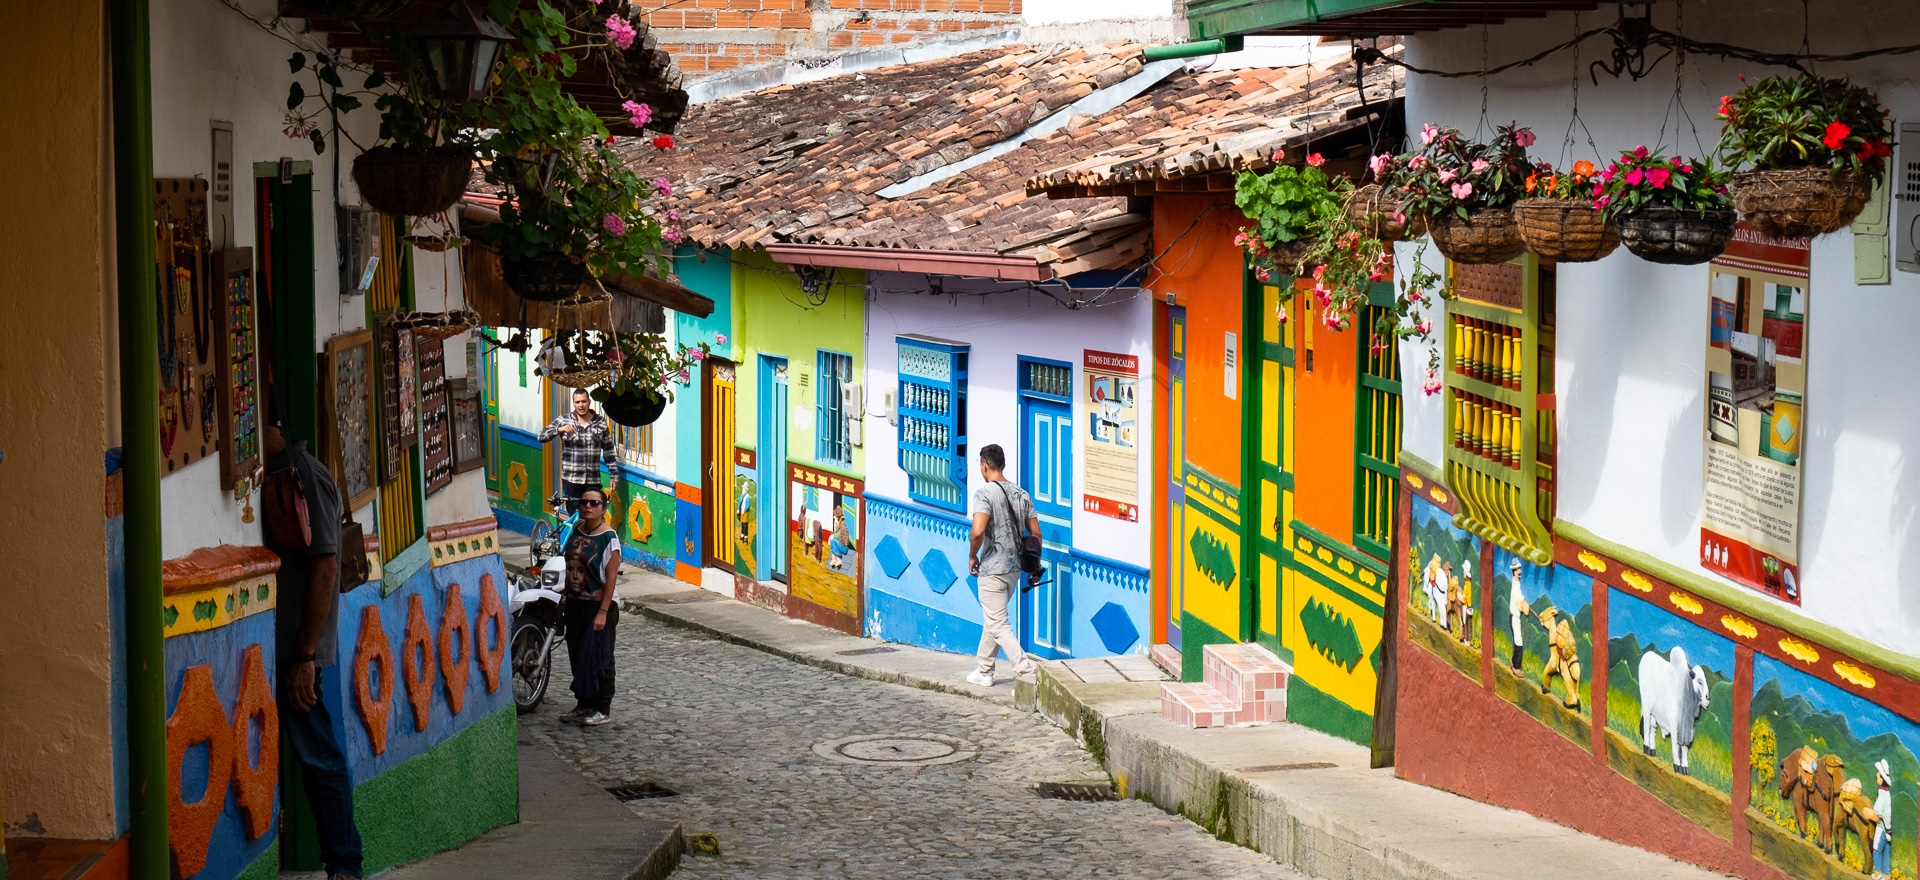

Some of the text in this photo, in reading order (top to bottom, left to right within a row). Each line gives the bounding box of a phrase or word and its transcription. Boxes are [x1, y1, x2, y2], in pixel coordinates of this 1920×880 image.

[1088, 355, 1135, 368] TIPOS DE ZÓCALOS
